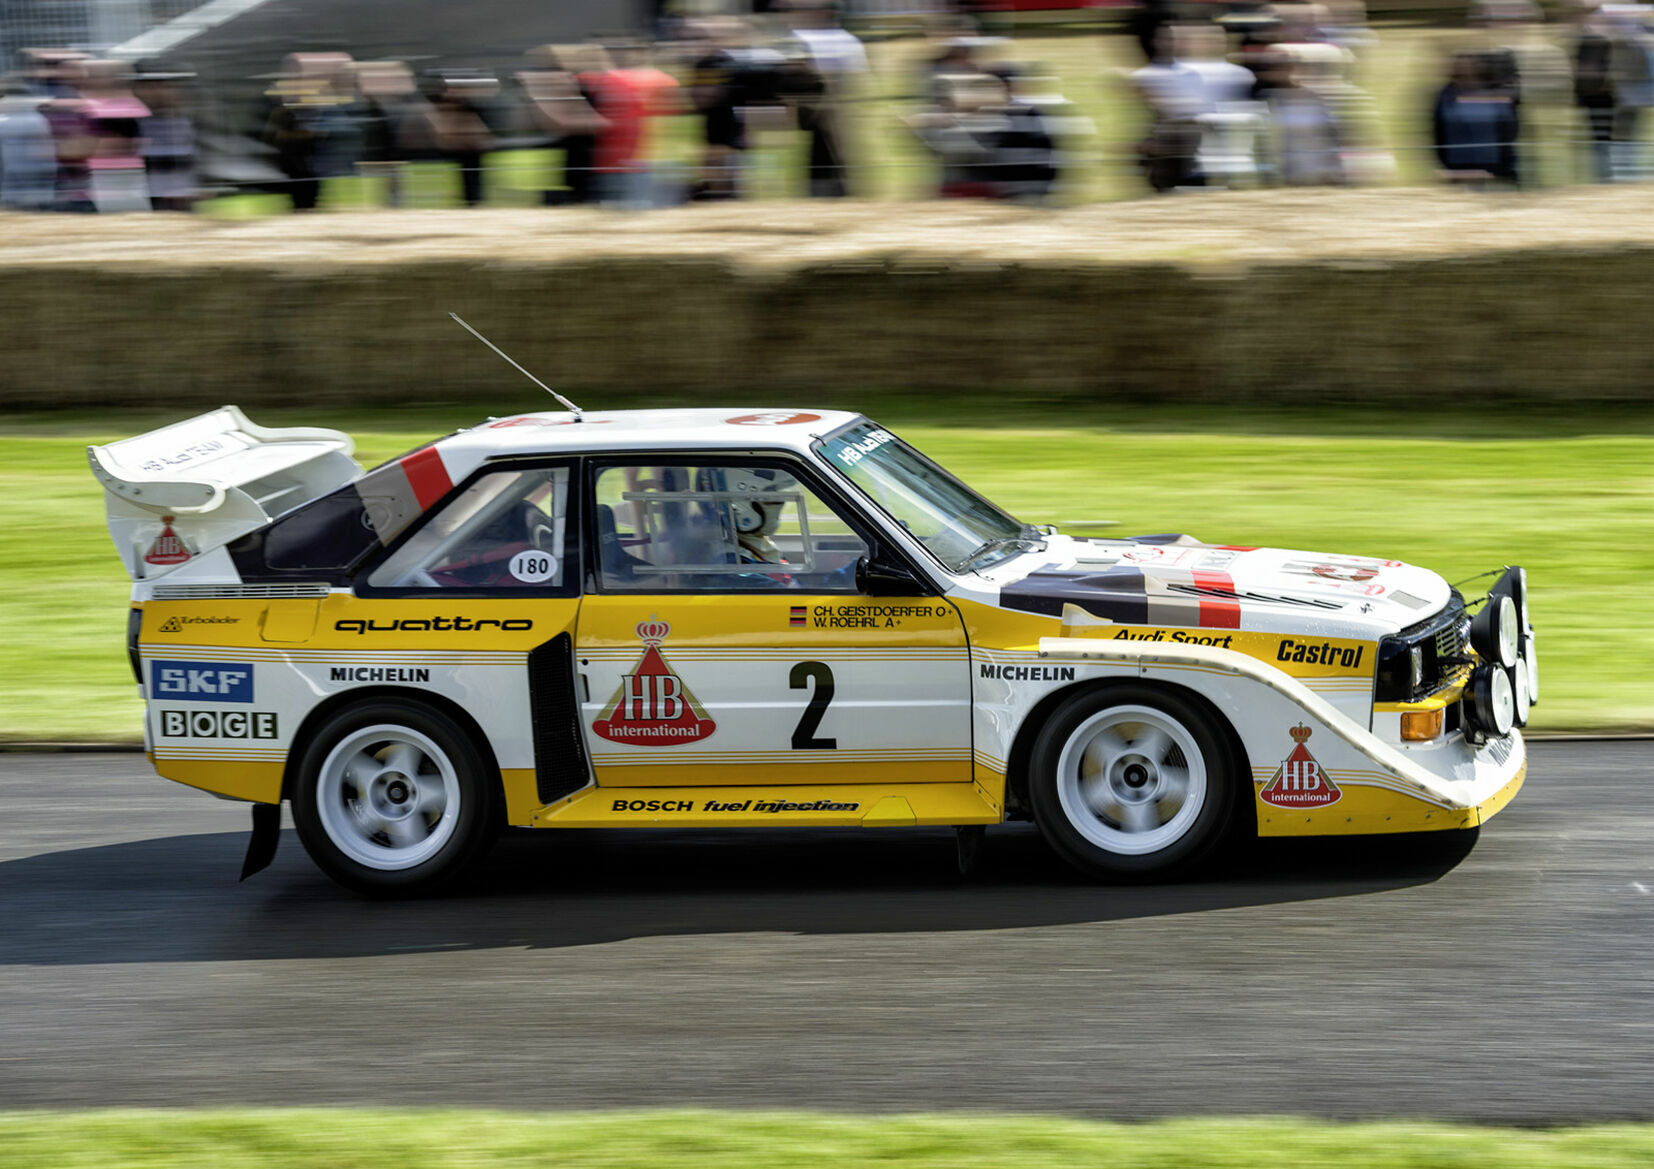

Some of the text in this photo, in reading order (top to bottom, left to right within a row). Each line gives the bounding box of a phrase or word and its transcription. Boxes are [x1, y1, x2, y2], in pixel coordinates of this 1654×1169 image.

[837, 446, 863, 467] HB
[517, 558, 549, 574] 180
[813, 606, 835, 617] CH.
[837, 606, 933, 617] GEISTDOERFER
[334, 615, 533, 635] quattro
[813, 617, 827, 628] W.
[830, 617, 880, 628] ROEHRL
[1113, 629, 1233, 649] Audi Sport
[1277, 640, 1364, 668] Castrol
[159, 669, 247, 694] SKF
[330, 667, 430, 682] MICHELIN
[980, 664, 1075, 681] MICHELIN
[621, 674, 684, 720] HB
[789, 661, 837, 750] 2
[163, 711, 276, 738] BOGE
[608, 723, 700, 737] international
[1281, 760, 1321, 791] HB
[612, 799, 860, 813] BOSCH fuel injection
[1271, 792, 1331, 802] international
